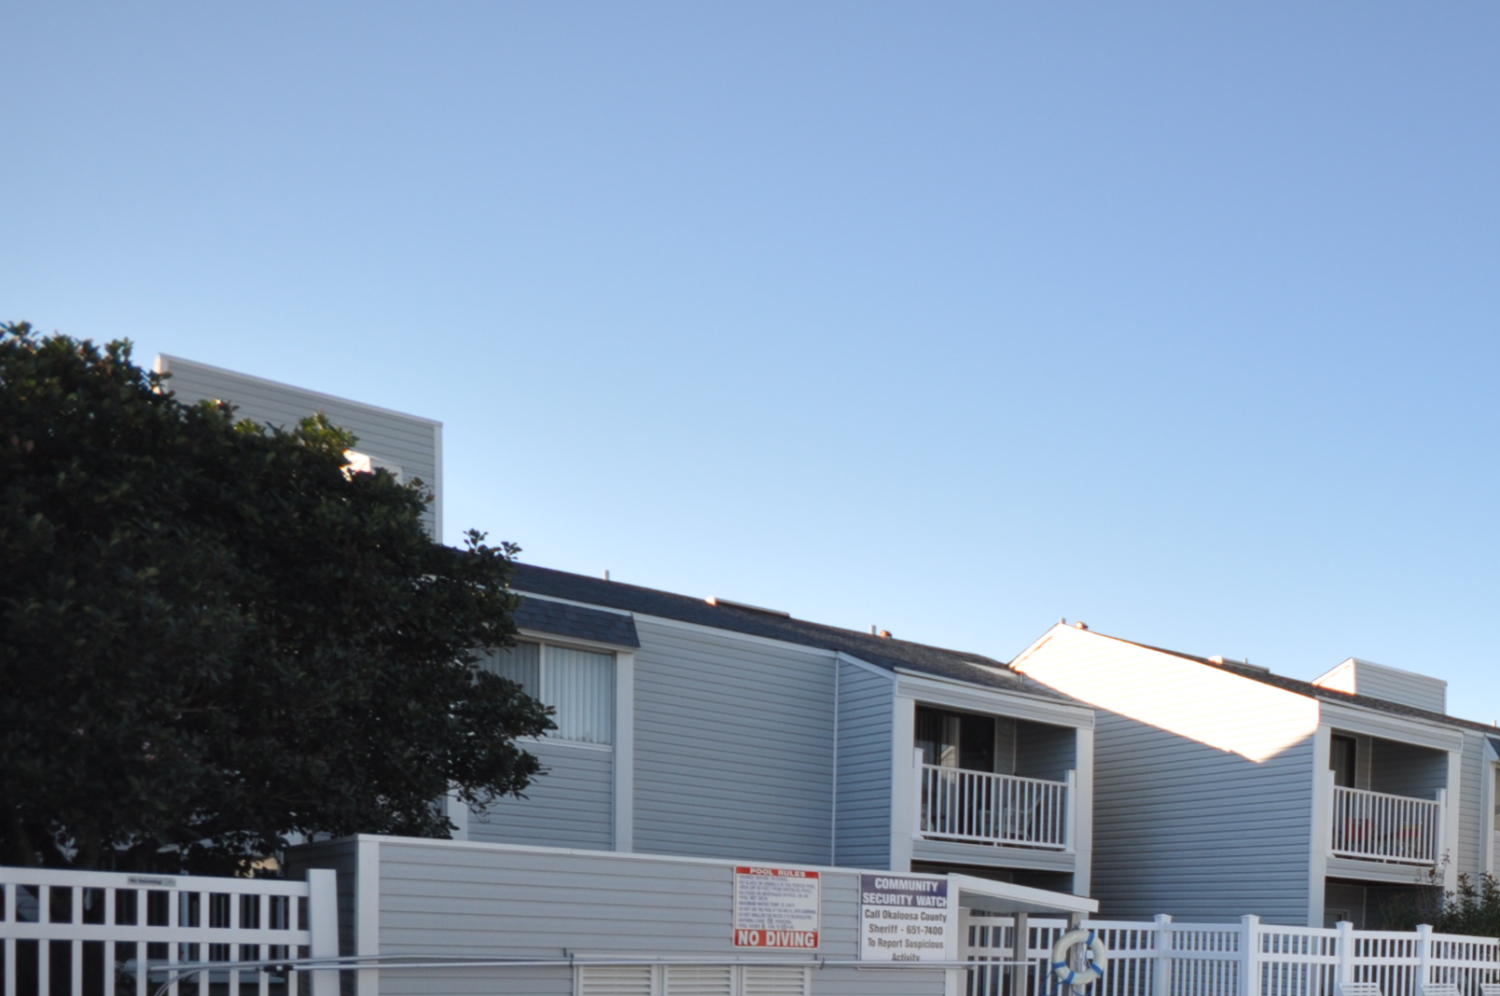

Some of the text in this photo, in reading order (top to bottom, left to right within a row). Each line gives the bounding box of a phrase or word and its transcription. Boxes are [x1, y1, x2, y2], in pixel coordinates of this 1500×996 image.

[874, 877, 938, 892] COMMUNITY
[862, 892, 913, 906] SECURITY
[864, 908, 947, 923] Call Okaloosa County
[868, 923, 898, 934] Sheriff
[906, 925, 944, 936] 651-7400
[738, 930, 815, 947] NO DIVING
[867, 937, 944, 949] To Report Suspicious
[891, 952, 920, 961] Activity
